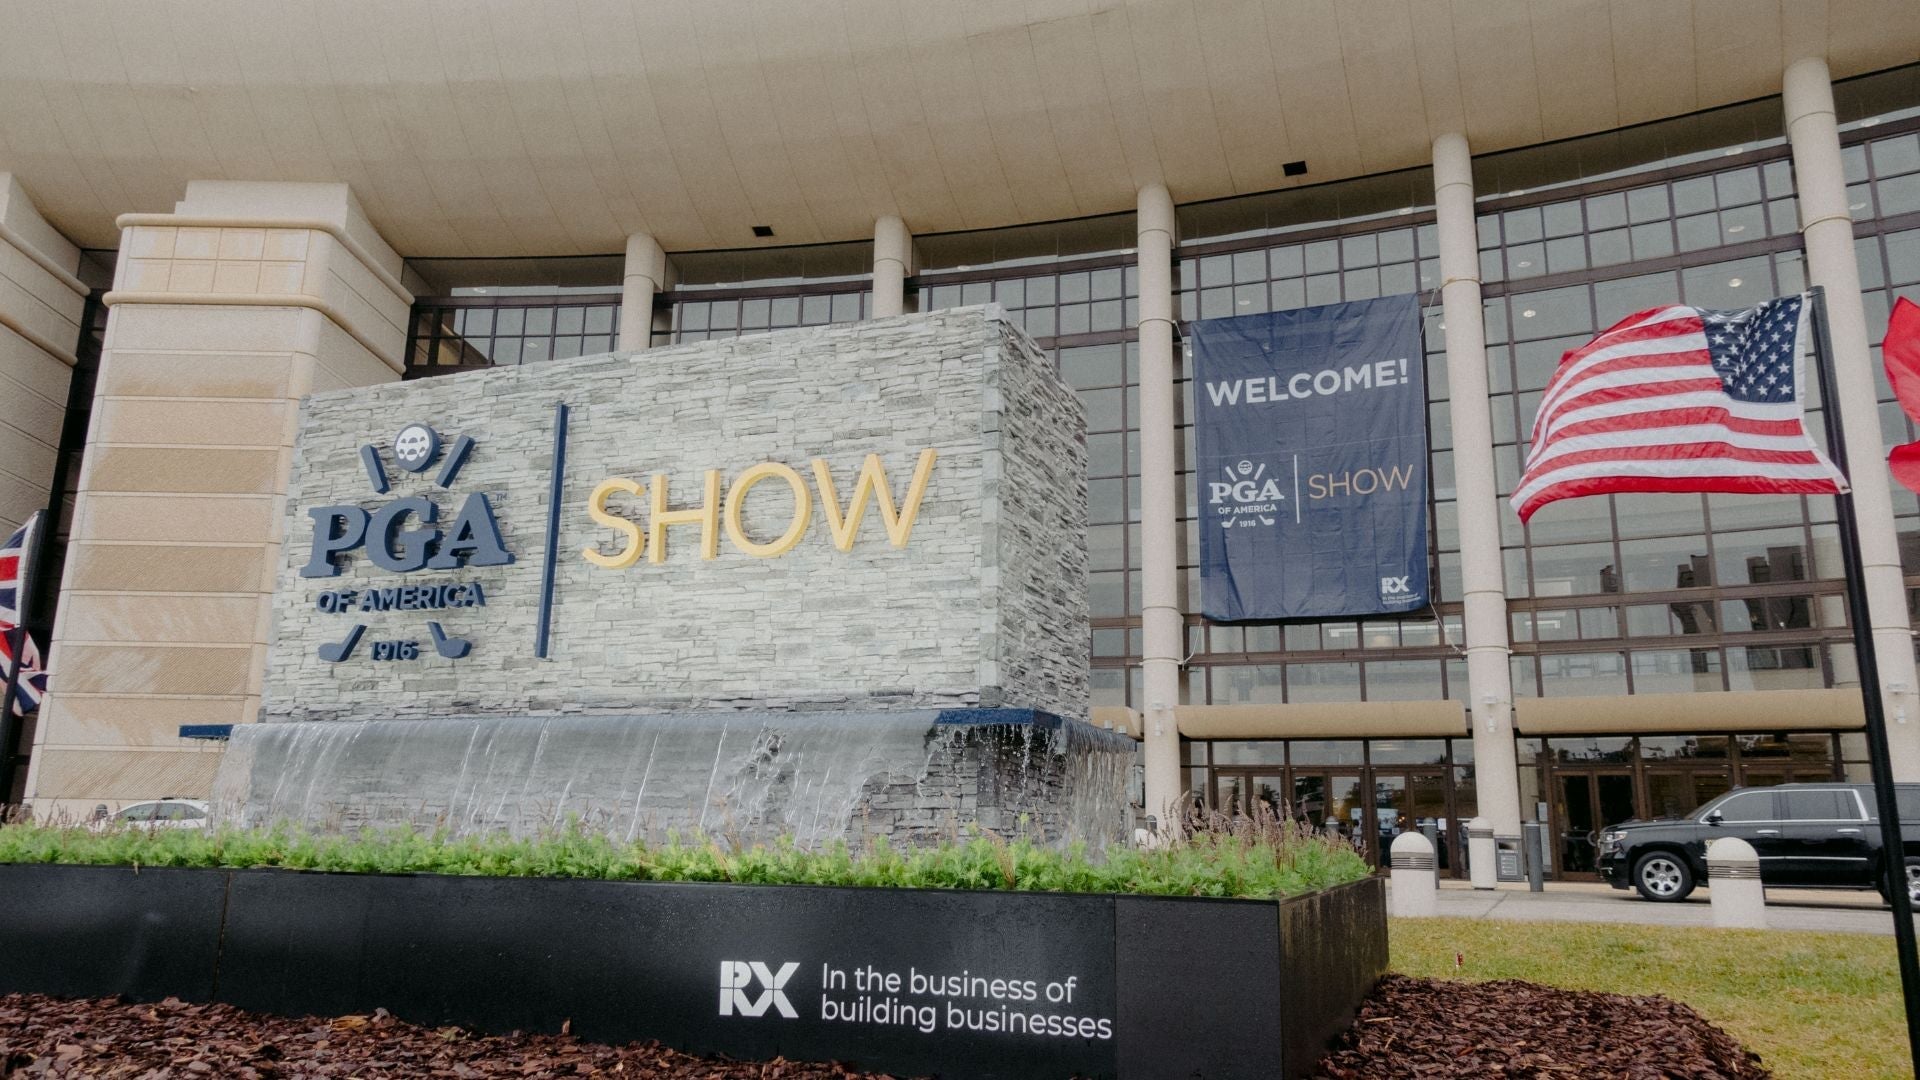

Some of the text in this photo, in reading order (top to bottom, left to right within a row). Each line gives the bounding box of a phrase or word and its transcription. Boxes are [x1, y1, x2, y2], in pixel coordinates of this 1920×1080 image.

[1206, 358, 1409, 407] WELCOME!
[1208, 479, 1285, 503] PGA
[1308, 464, 1413, 499] SHOW
[582, 448, 938, 570] SHOW
[1233, 504, 1277, 514] AMERICA
[300, 492, 516, 578] PGA
[316, 581, 487, 613] OF AMERICA
[1382, 575, 1410, 594] RX
[370, 640, 420, 660] 1916
[719, 960, 800, 1018] RX
[822, 963, 1077, 1003] In the business of
[821, 994, 1112, 1040] building businesses
